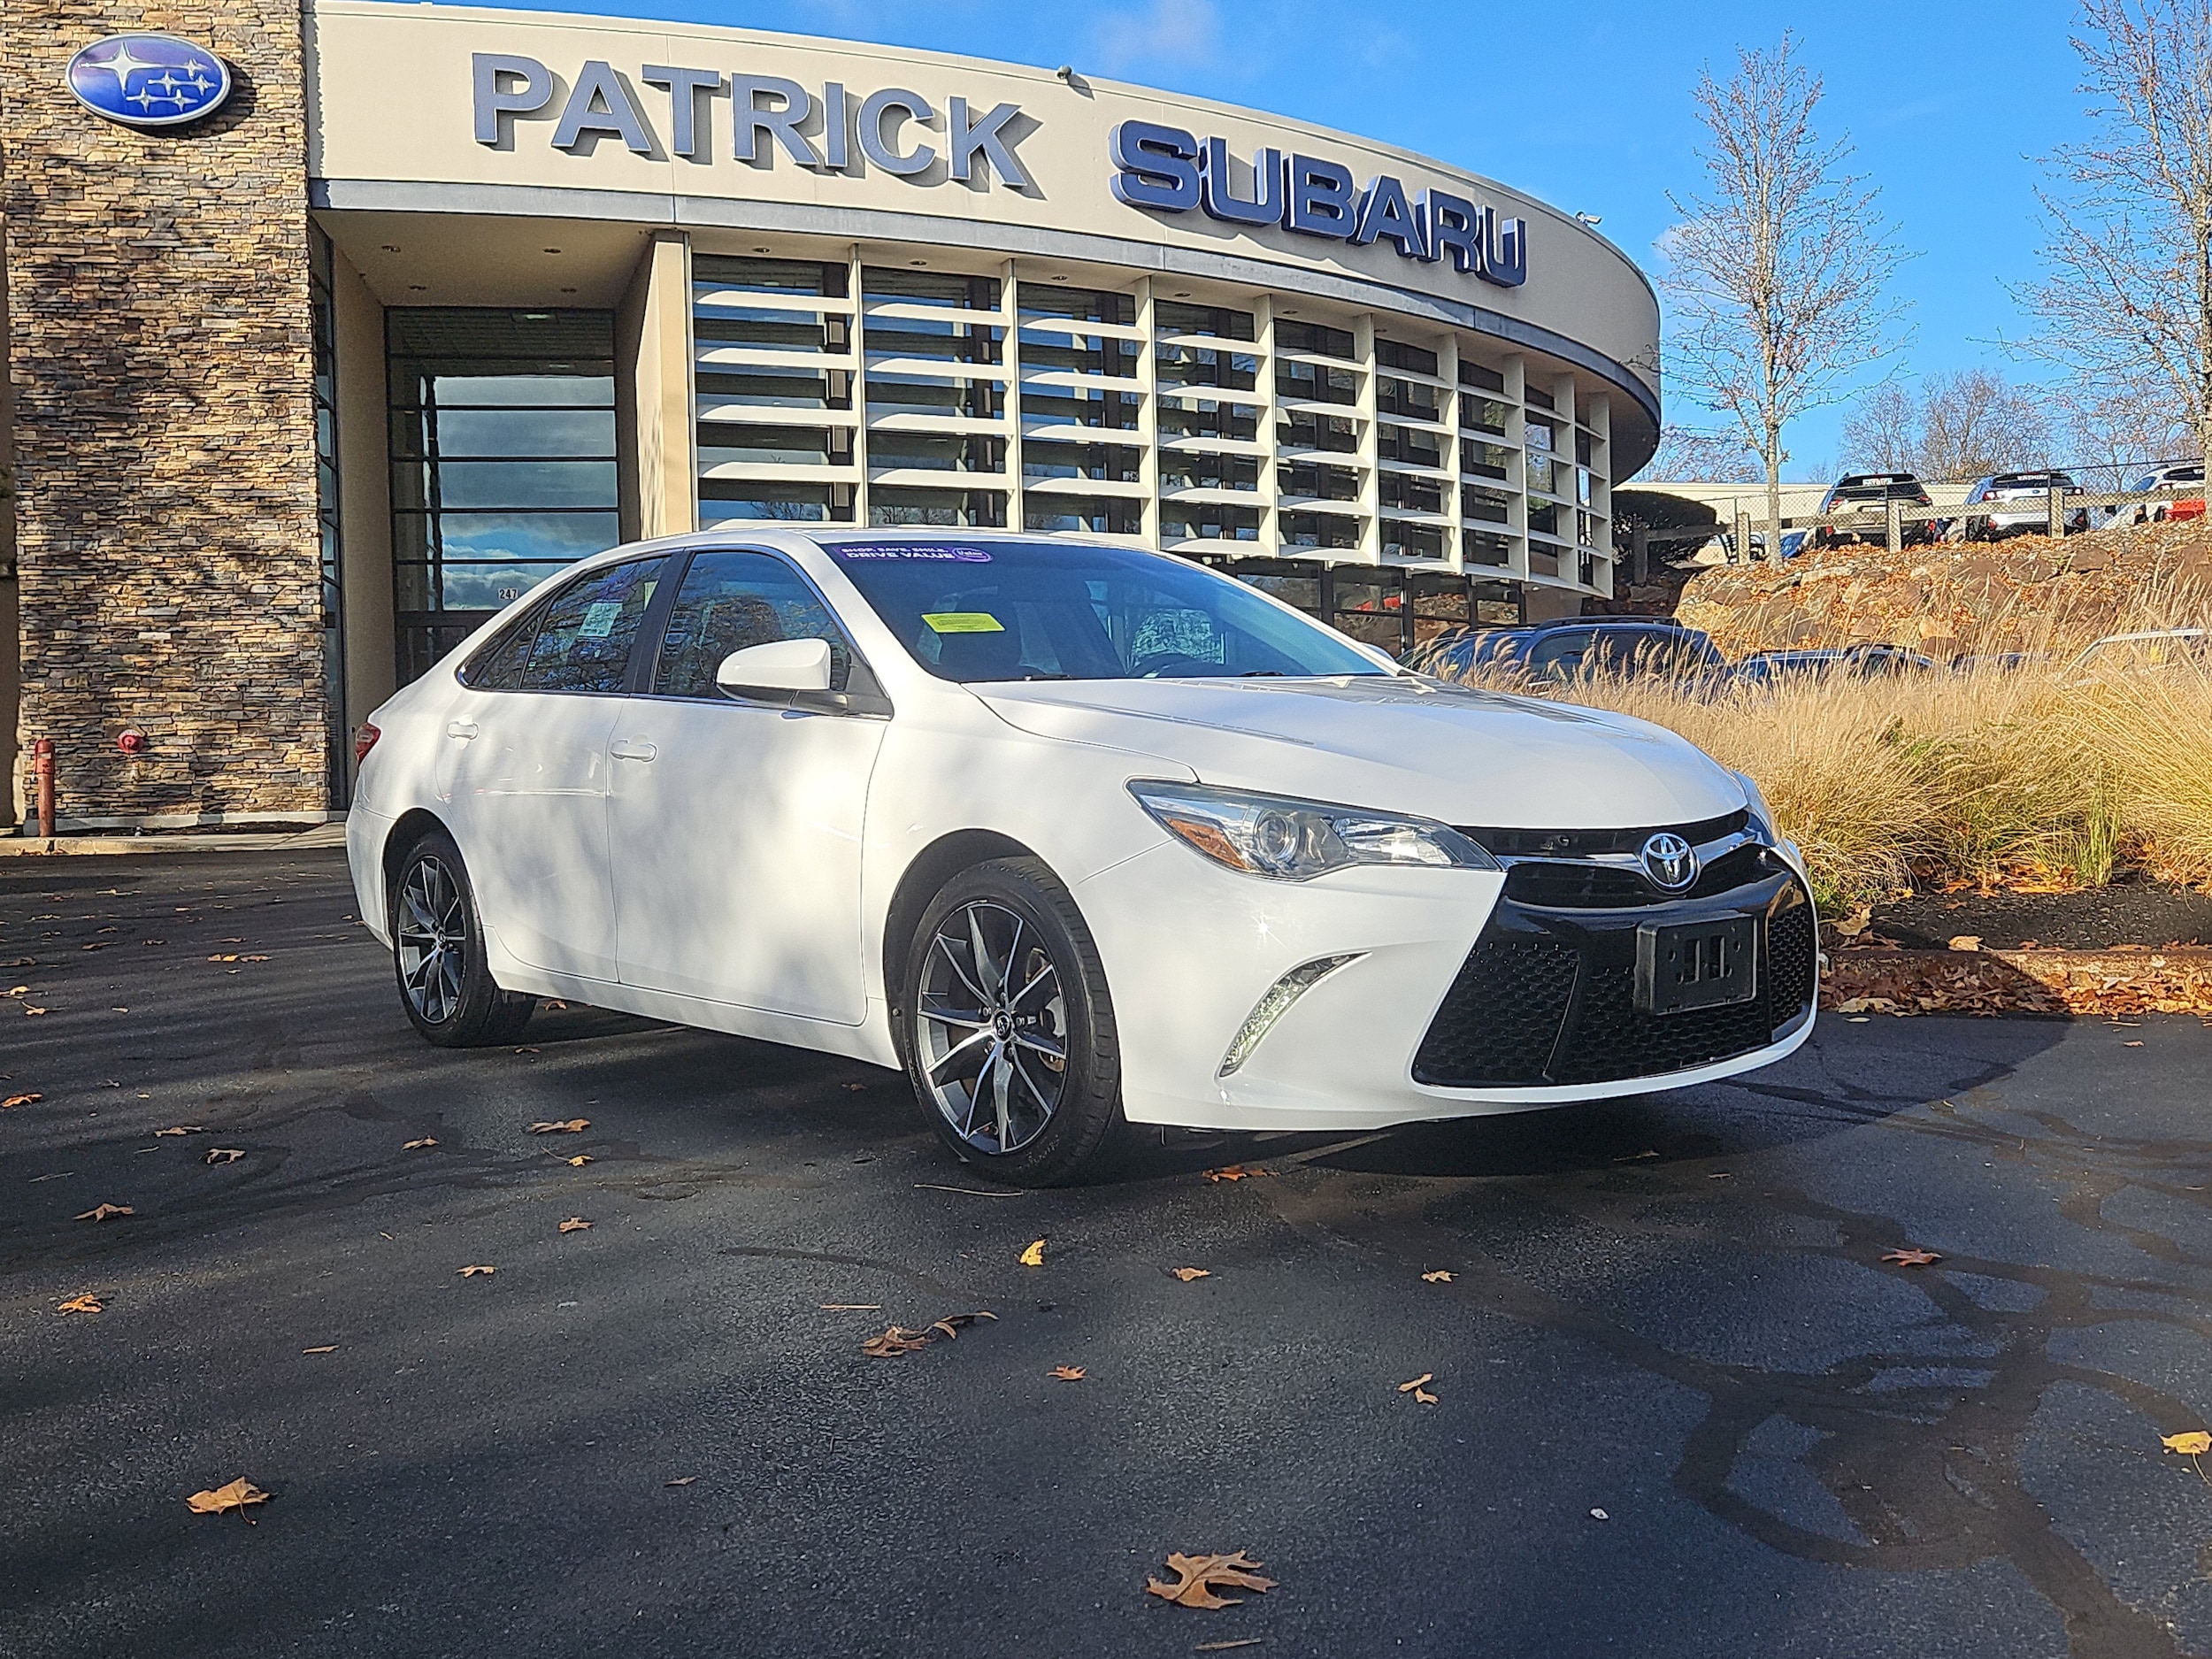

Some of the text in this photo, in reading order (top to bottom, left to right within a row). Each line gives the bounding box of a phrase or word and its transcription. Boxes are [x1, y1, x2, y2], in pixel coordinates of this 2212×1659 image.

[472, 51, 1527, 288] PATRICK SUBARU
[499, 588, 518, 600] 247
